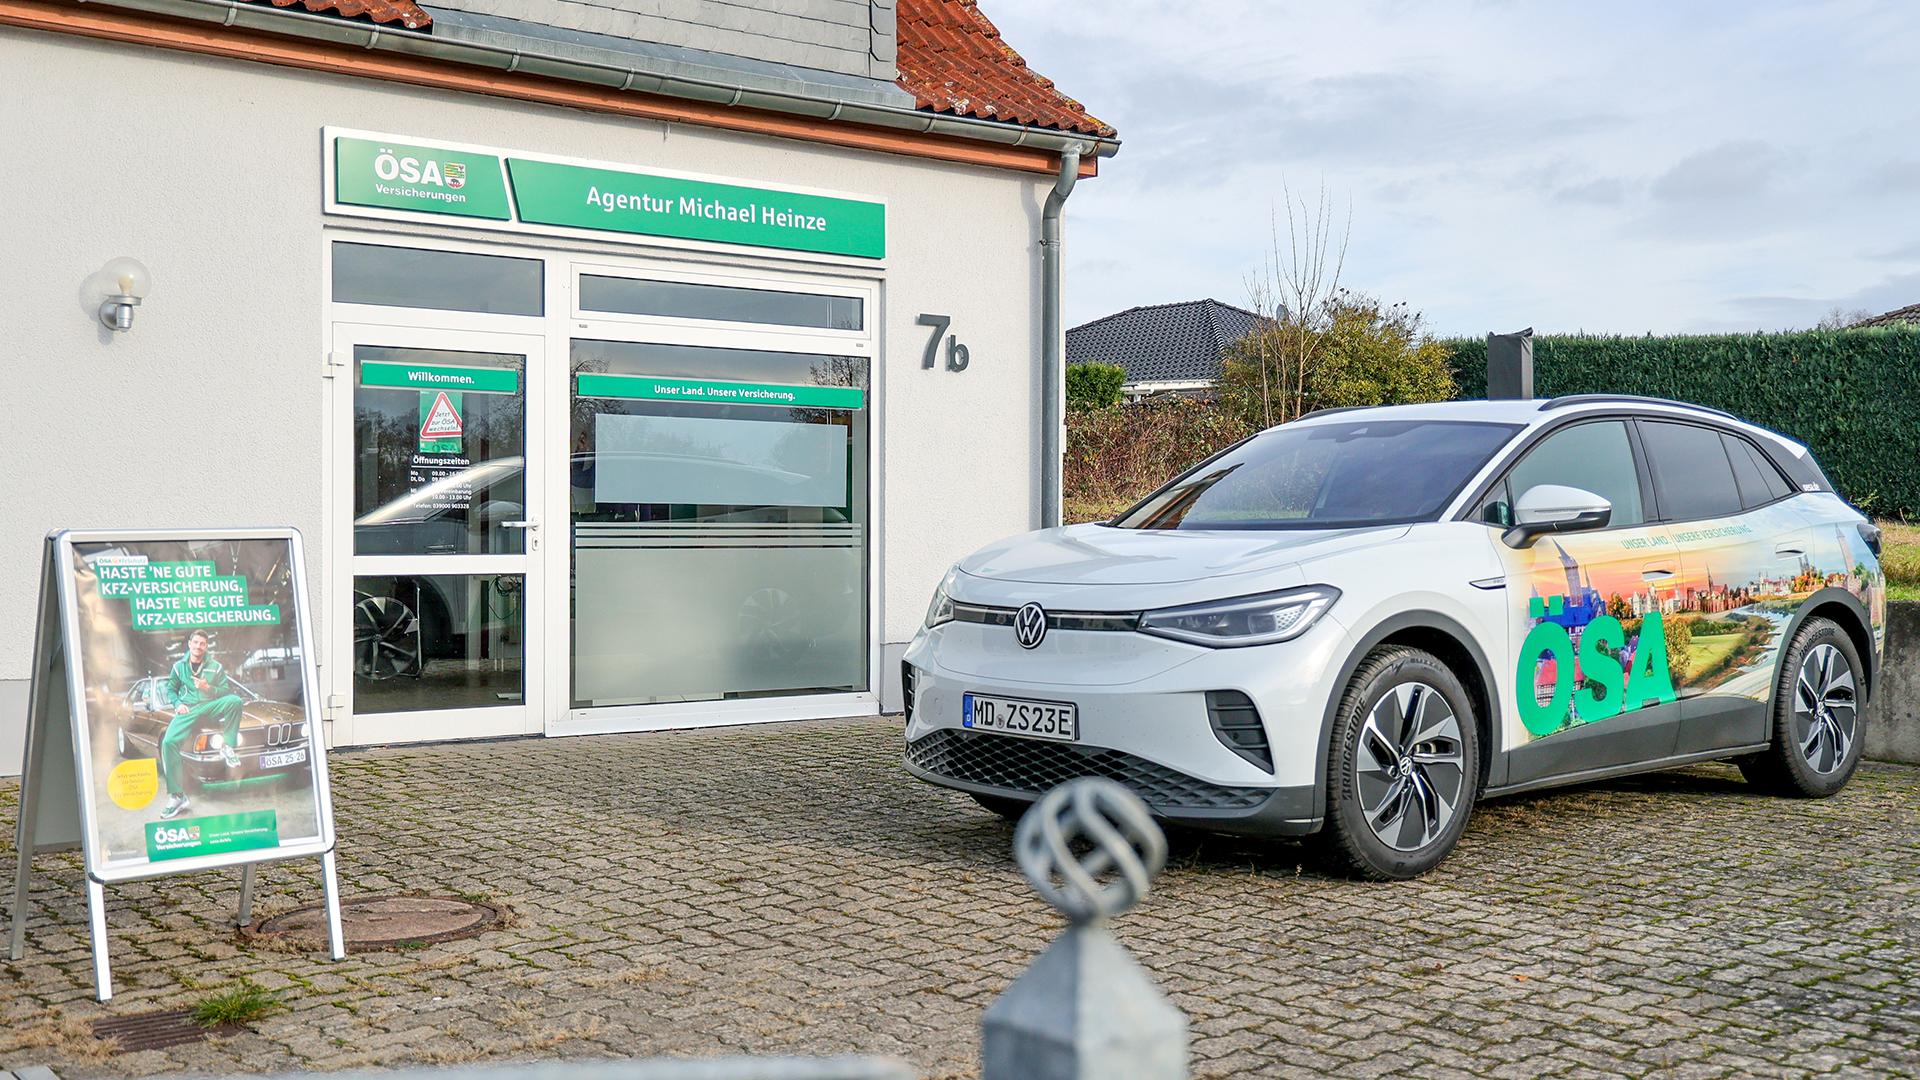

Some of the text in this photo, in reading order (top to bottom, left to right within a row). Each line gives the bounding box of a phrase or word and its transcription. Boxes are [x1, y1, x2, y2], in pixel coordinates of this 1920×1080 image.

[374, 147, 444, 187] ÖSA
[375, 183, 466, 203] Versicherungen
[586, 186, 827, 232] Agentur Michael Heinze
[919, 313, 970, 373] 7b
[407, 371, 475, 384] Willkommen.
[654, 384, 796, 402] Unser Land. Unsere Versicherung.
[412, 454, 470, 466] Öffnungszeiten
[1621, 524, 1754, 550] UNSER LAND. UNSERE VERSICHERUNG.
[100, 566, 147, 580] HASTE
[175, 565, 212, 578] GUTE
[101, 579, 243, 596] KFZ-VERSICHERUNG,
[135, 596, 181, 610] HASTE
[208, 594, 245, 608] GUTE
[136, 609, 276, 626] KFZ-VERSICHERUNG.
[1515, 594, 1678, 736] ÖSA
[973, 699, 995, 726] MD
[1006, 703, 1071, 736] ZS23E
[1341, 697, 1368, 801] BRIDGESTONE
[265, 756, 283, 767] ÖSA
[154, 826, 190, 844] ÖSA
[155, 840, 202, 851] Versicherungen
